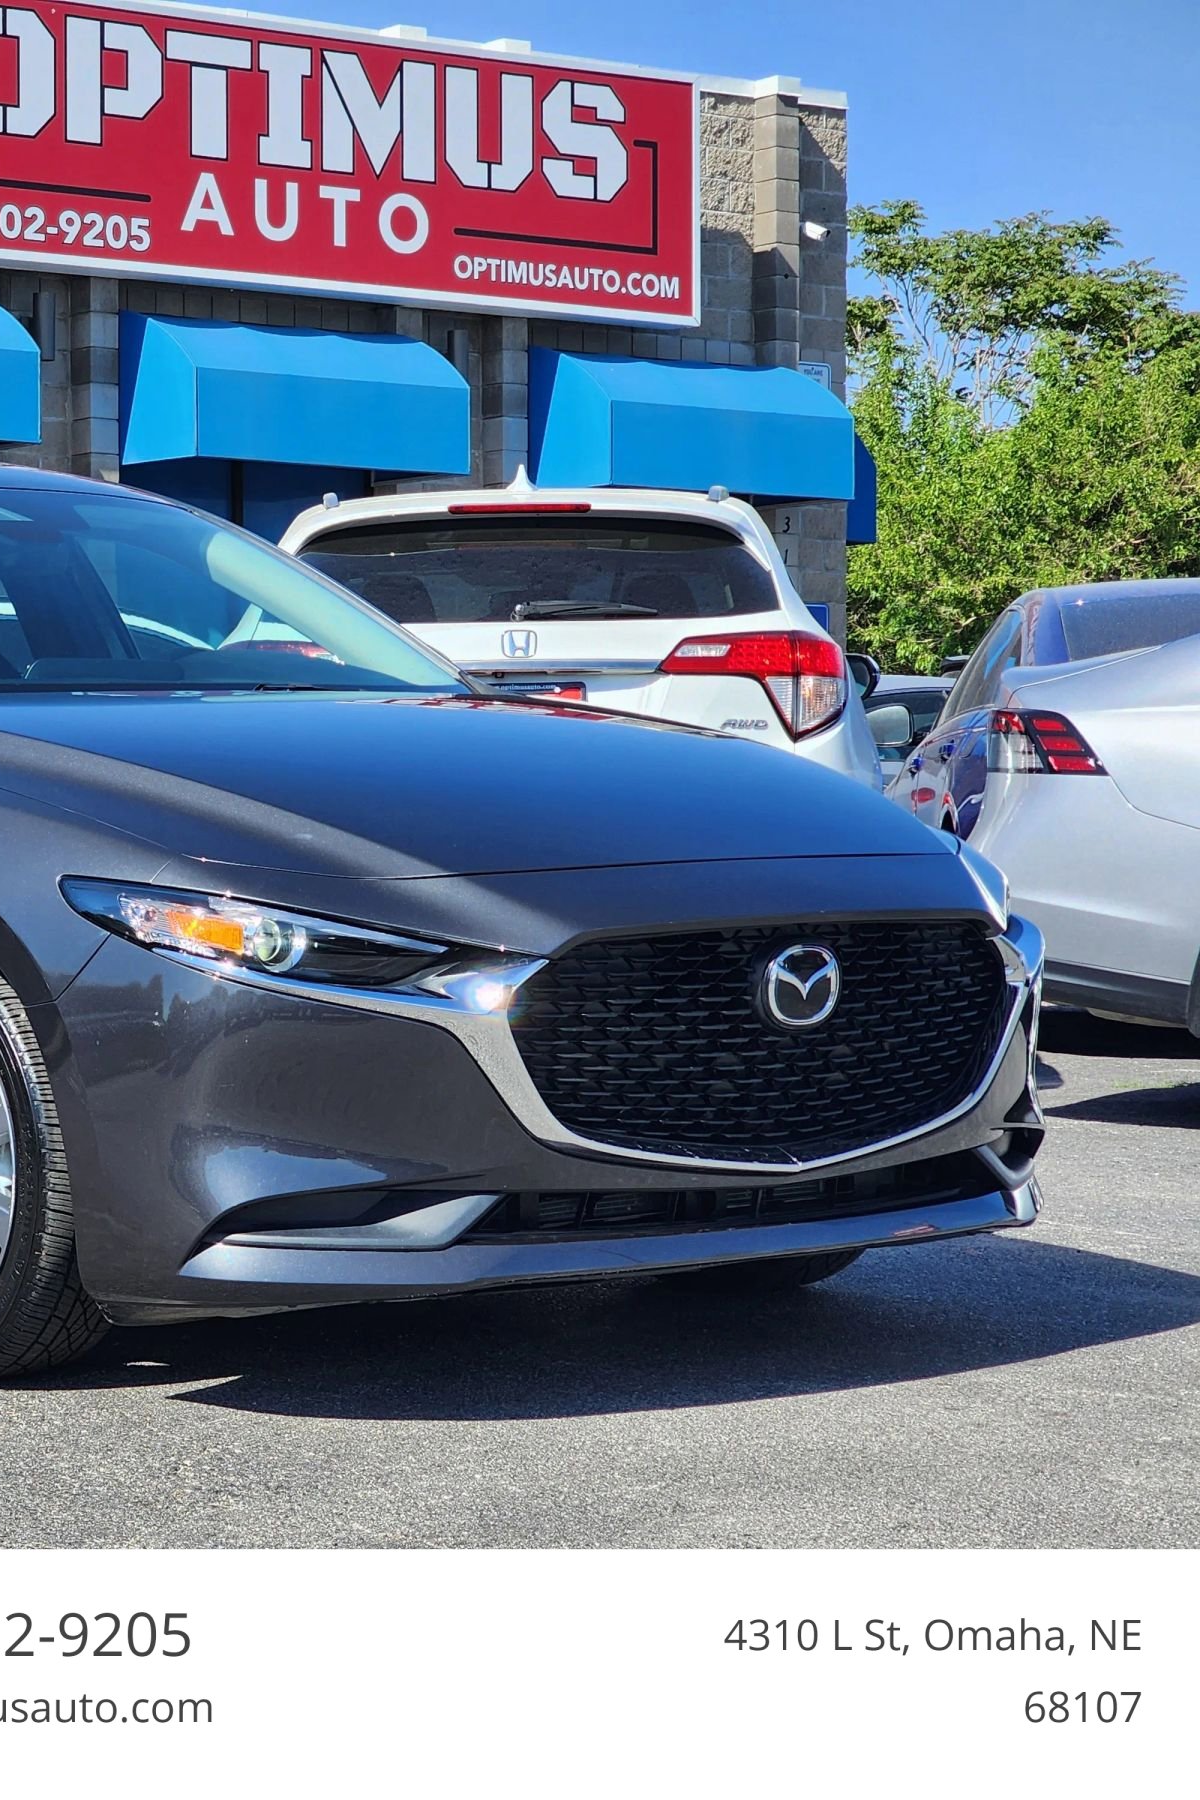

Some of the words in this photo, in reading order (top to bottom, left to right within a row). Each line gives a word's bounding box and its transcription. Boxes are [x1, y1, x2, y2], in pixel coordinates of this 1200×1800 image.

[180, 173, 430, 255] AUTO
[453, 254, 681, 299] OPTIMUSAUTO.COM
[782, 516, 791, 533] 3
[720, 718, 769, 731] AWD
